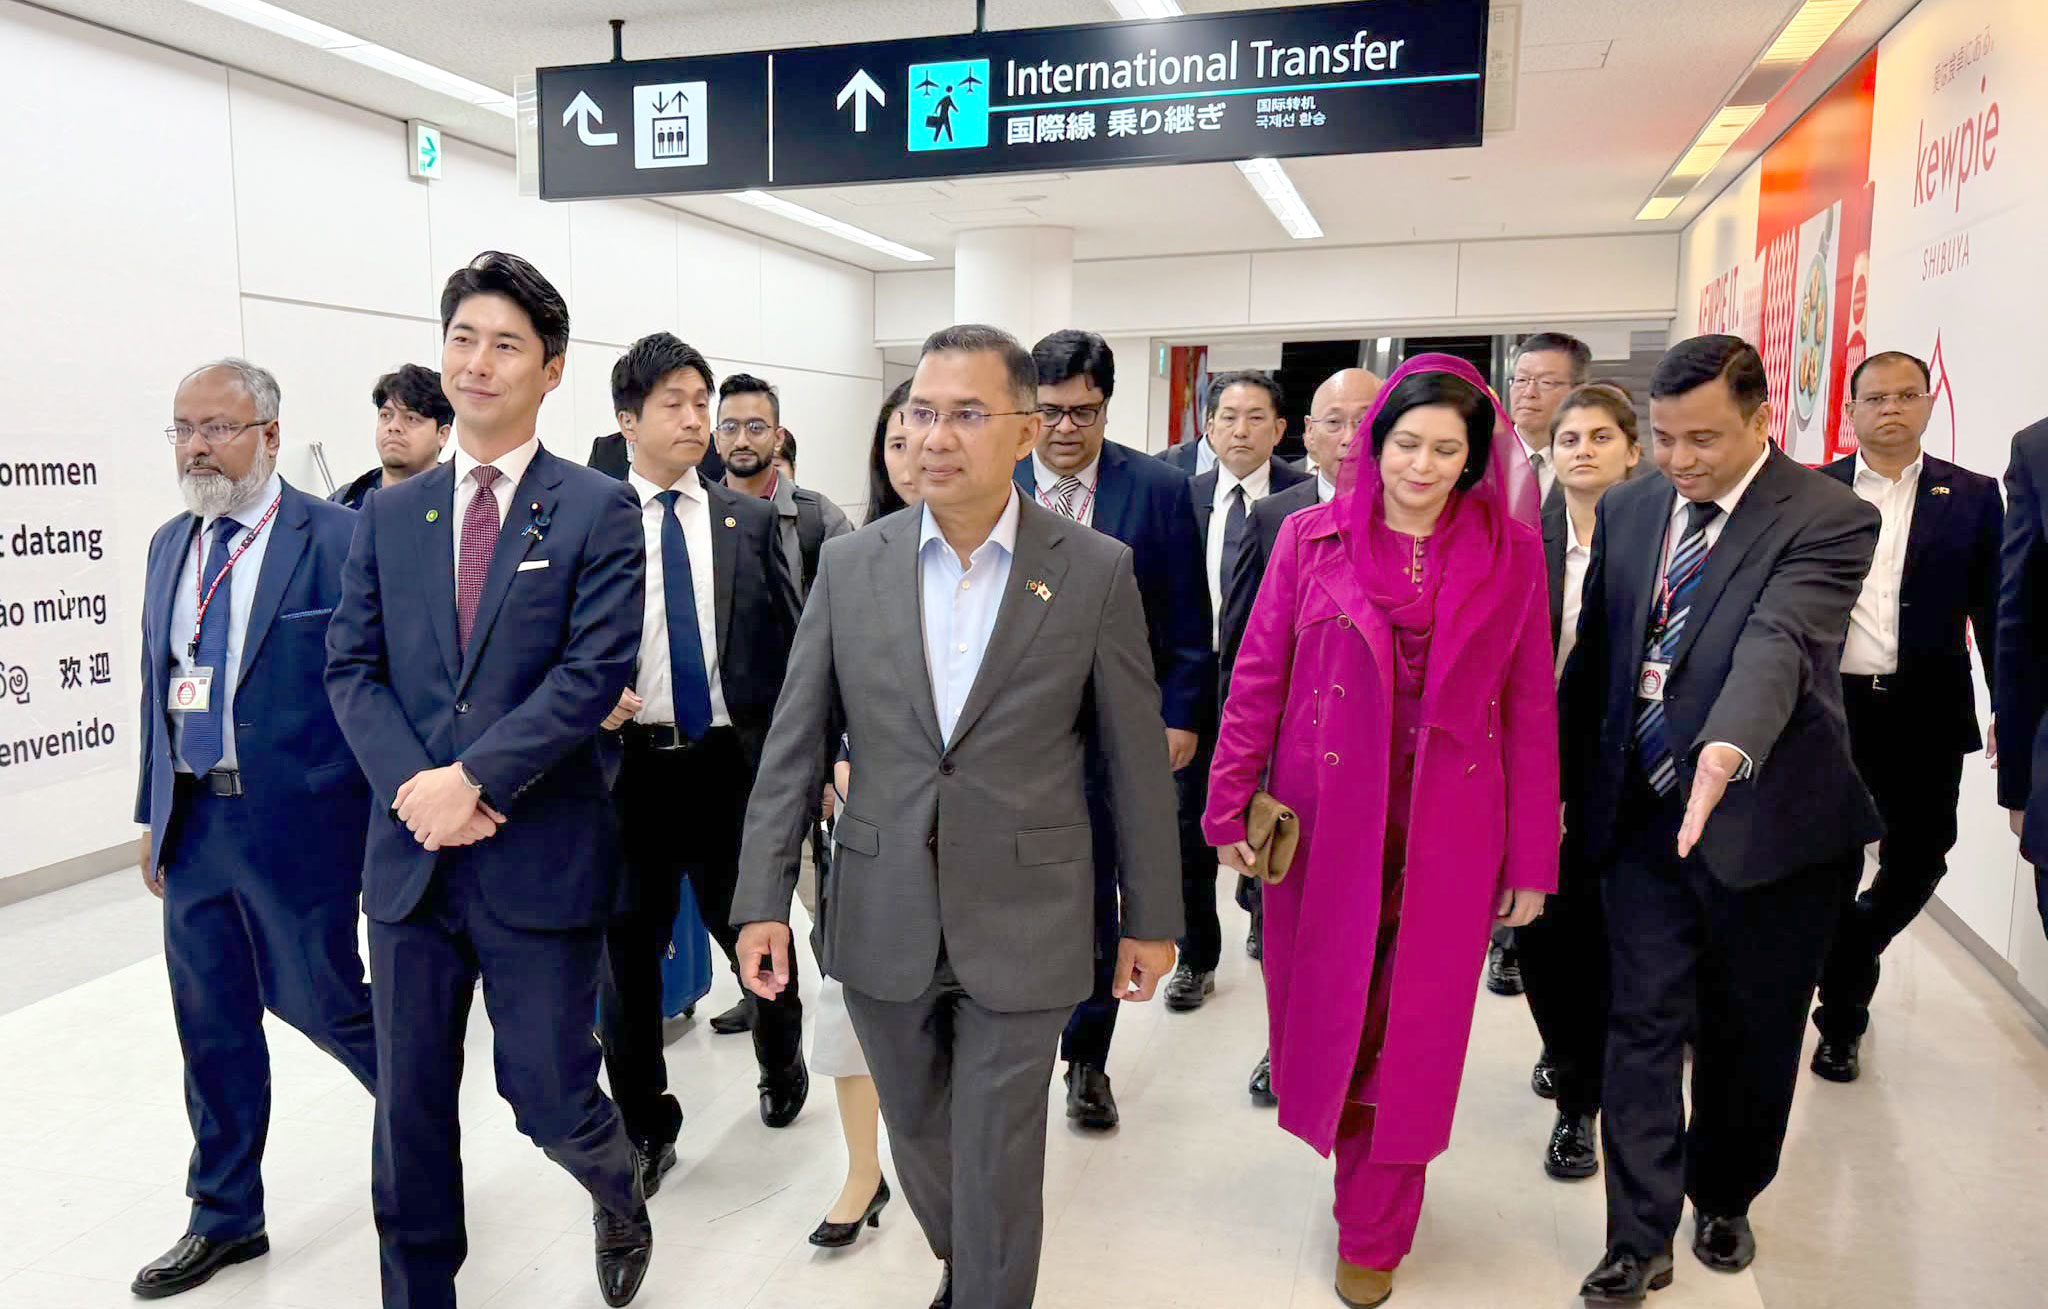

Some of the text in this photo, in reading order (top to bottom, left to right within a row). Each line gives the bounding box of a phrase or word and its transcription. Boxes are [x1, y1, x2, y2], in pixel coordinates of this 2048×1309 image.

[1007, 30, 1405, 97] International Transfer
[1007, 102, 1226, 145] 国際線 乗り継ぎ
[1255, 111, 1327, 129] 국제선 환승
[1256, 95, 1316, 113] 国际转机
[1913, 74, 2000, 213] kewpie
[1922, 231, 1970, 281] SHIBUYA
[0, 462, 97, 487] ommen
[12, 523, 104, 560] datang
[34, 589, 107, 625] mừng
[0, 712, 116, 768] envenido
